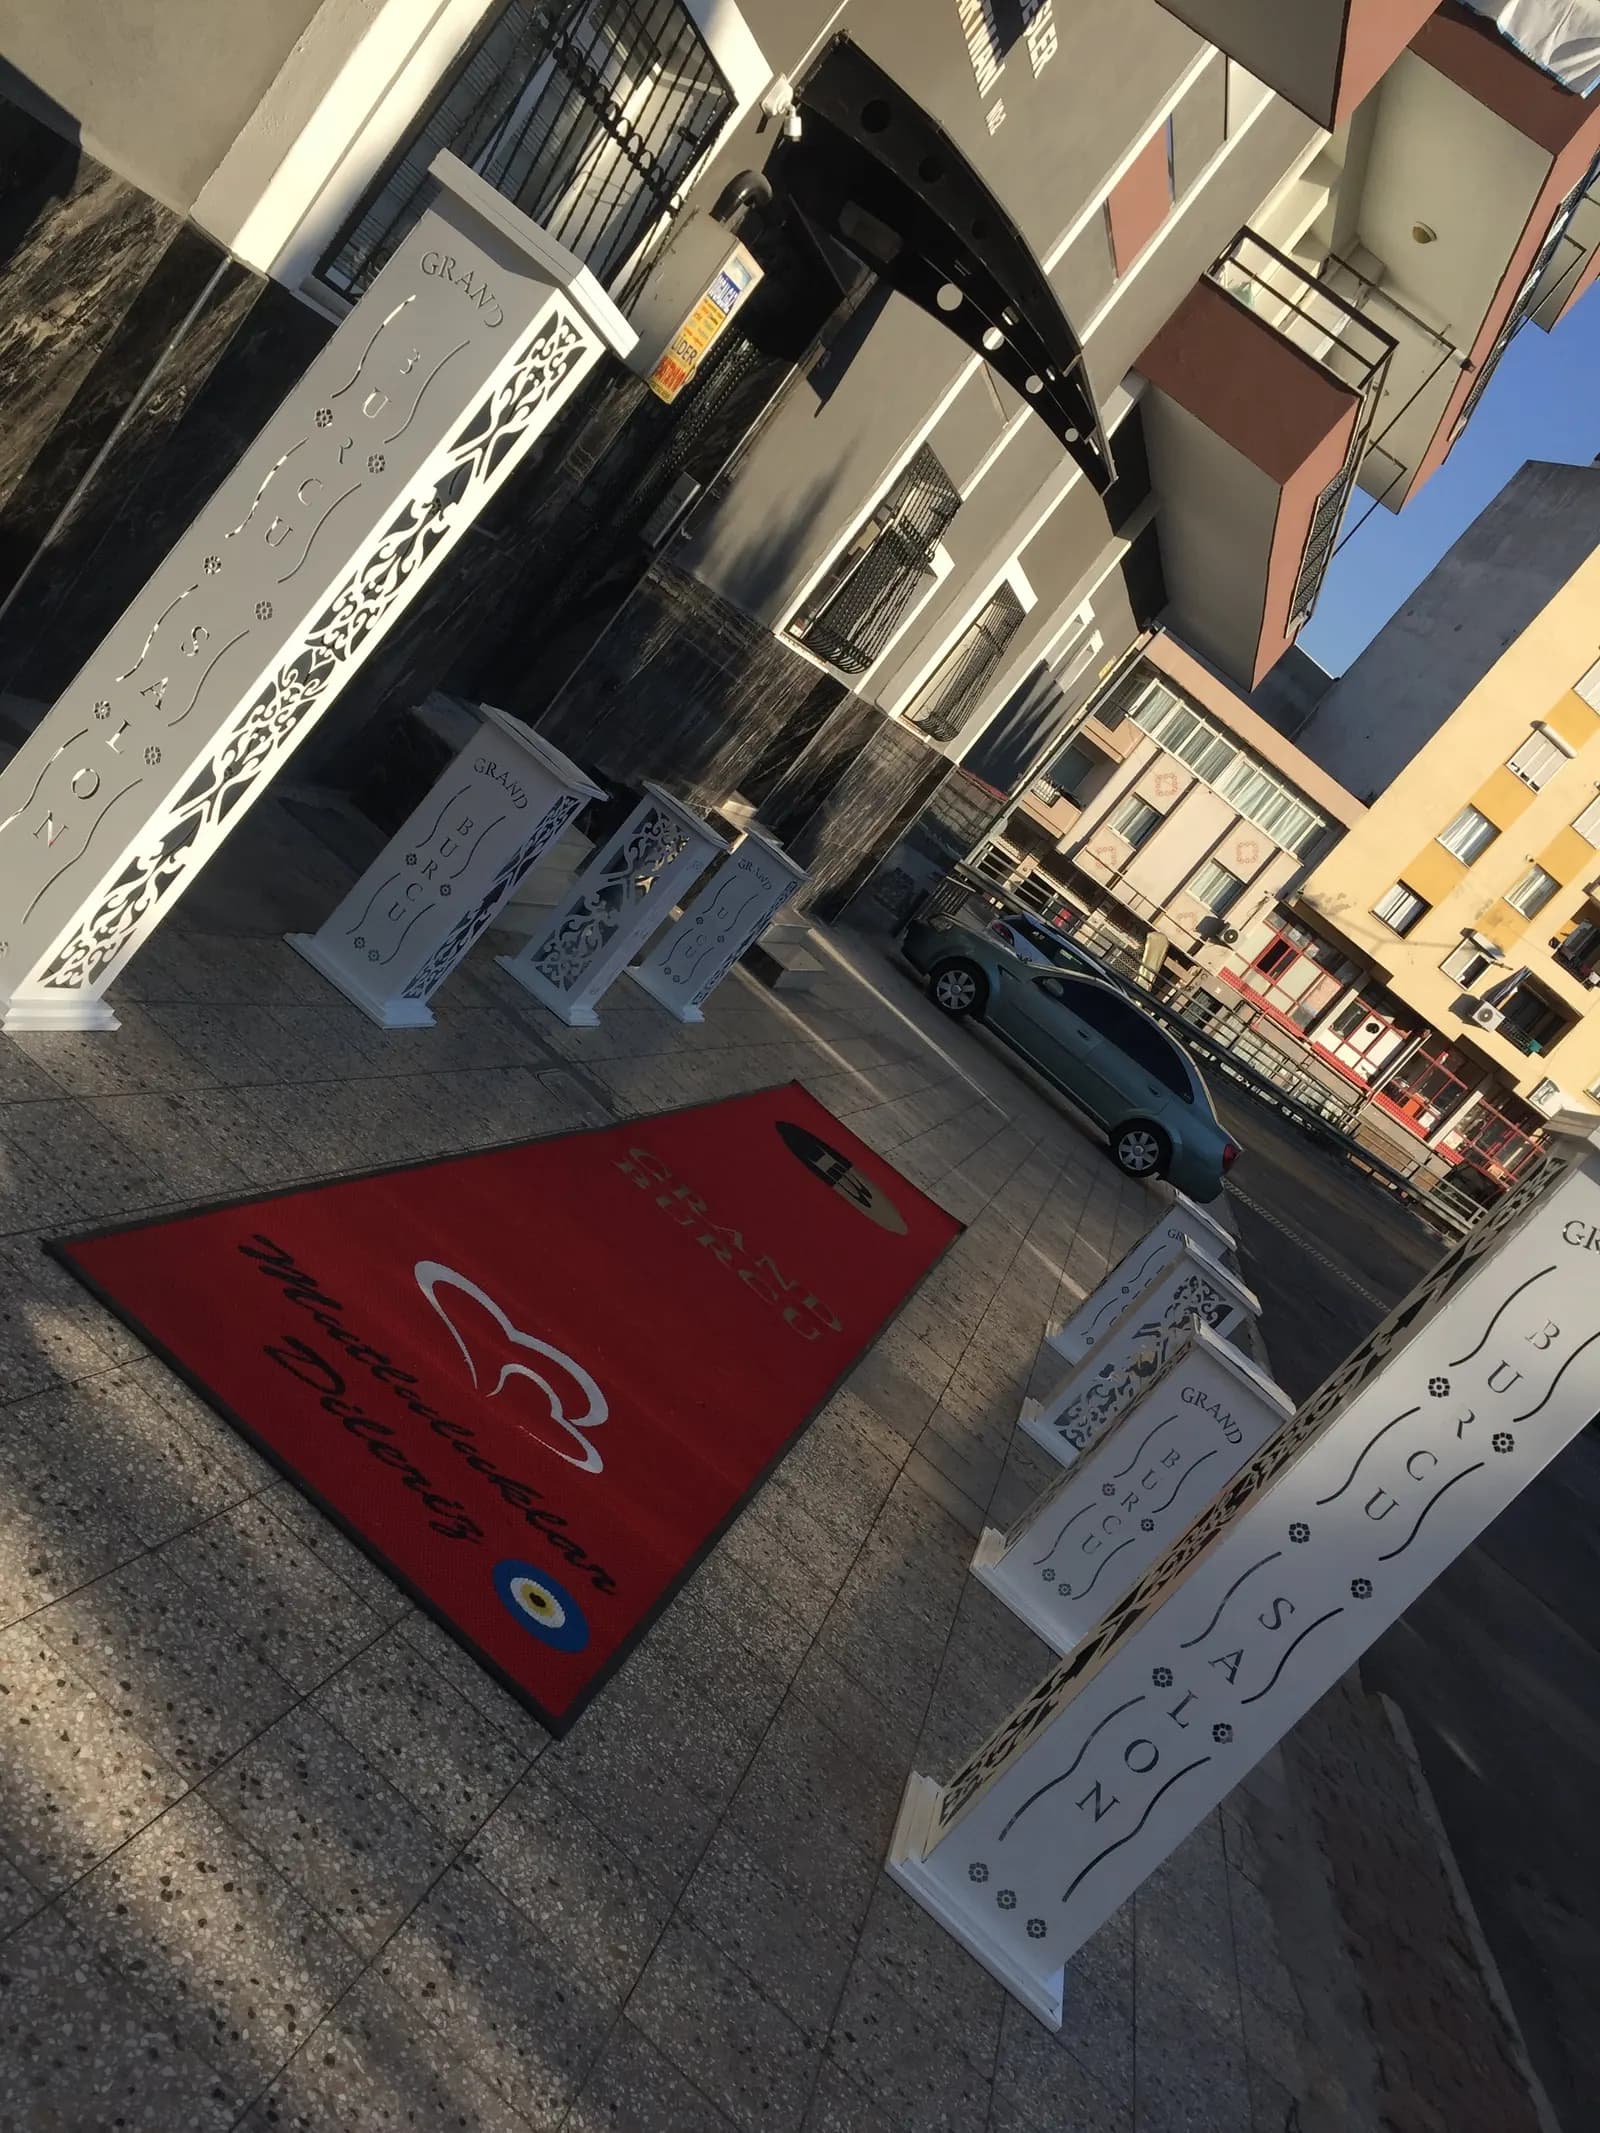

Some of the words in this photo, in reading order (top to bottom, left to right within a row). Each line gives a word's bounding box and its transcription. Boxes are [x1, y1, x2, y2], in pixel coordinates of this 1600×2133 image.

[420, 251, 504, 328] GRAND
[33, 626, 210, 848] SALON
[473, 757, 529, 809] GRAND
[388, 817, 474, 921] BURCU
[737, 857, 772, 891] GRAND
[609, 1159, 822, 1340] BURCU
[628, 1148, 842, 1332] GRAND
[263, 1335, 484, 1543] Dileriz
[1181, 1386, 1243, 1444] GRAND
[1365, 1319, 1561, 1521] BURCU
[1082, 1448, 1181, 1554] BURCU
[1075, 1597, 1295, 1823] SALON
